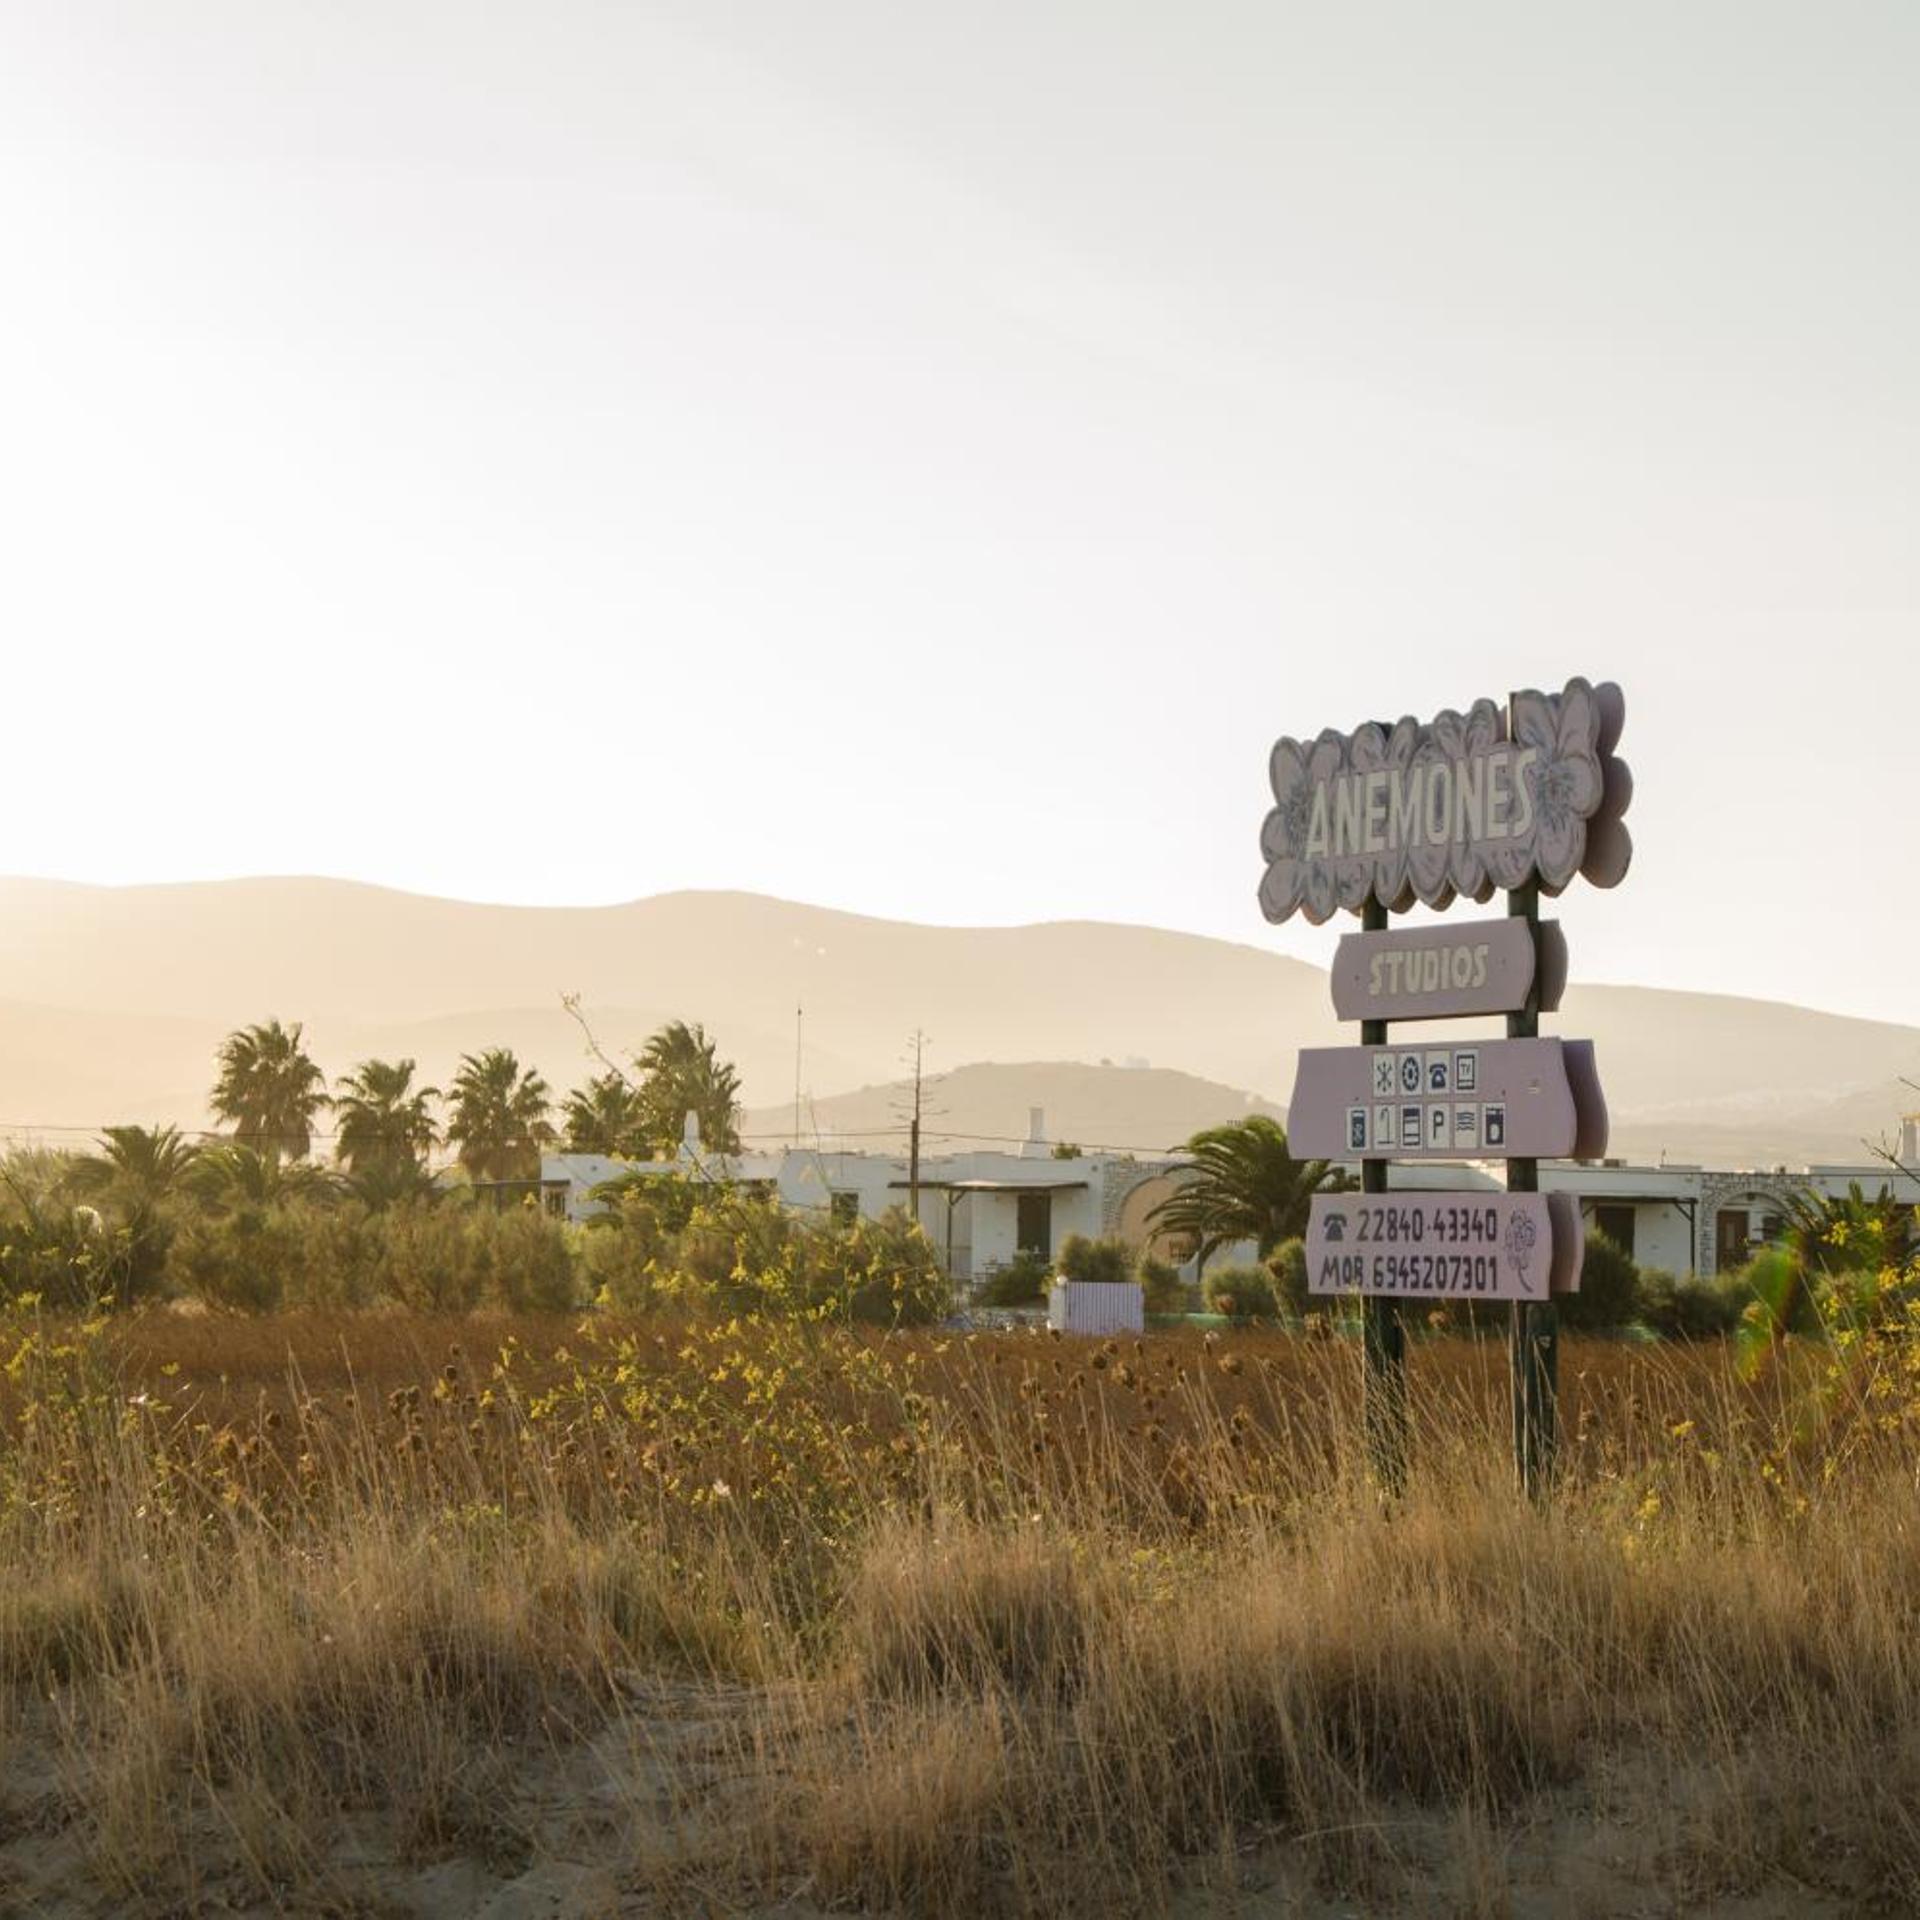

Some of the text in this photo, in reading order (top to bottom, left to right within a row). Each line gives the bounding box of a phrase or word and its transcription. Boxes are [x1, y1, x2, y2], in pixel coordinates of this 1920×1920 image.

[1306, 748, 1536, 861] ANEMONES
[1369, 945, 1489, 996] STUDIOS
[1433, 1111, 1444, 1140] P
[1373, 1256, 1497, 1291] 6945207301
